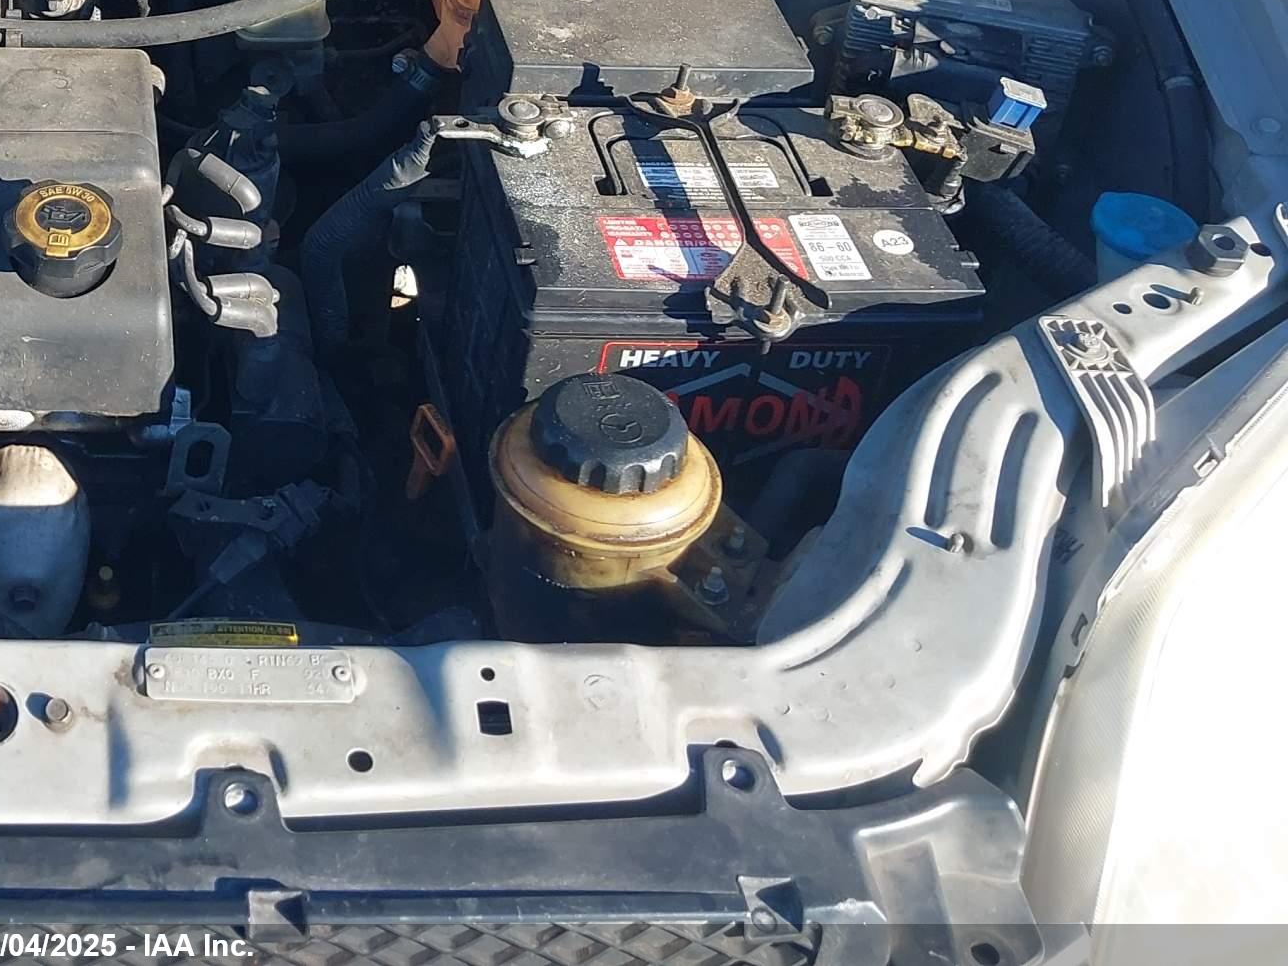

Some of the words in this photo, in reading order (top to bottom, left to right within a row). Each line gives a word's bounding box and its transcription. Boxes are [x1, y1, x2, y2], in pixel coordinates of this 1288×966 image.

[39, 186, 63, 198] SAE
[880, 236, 909, 248] A23
[619, 349, 721, 369] HEAVY
[789, 350, 872, 370] DUTY
